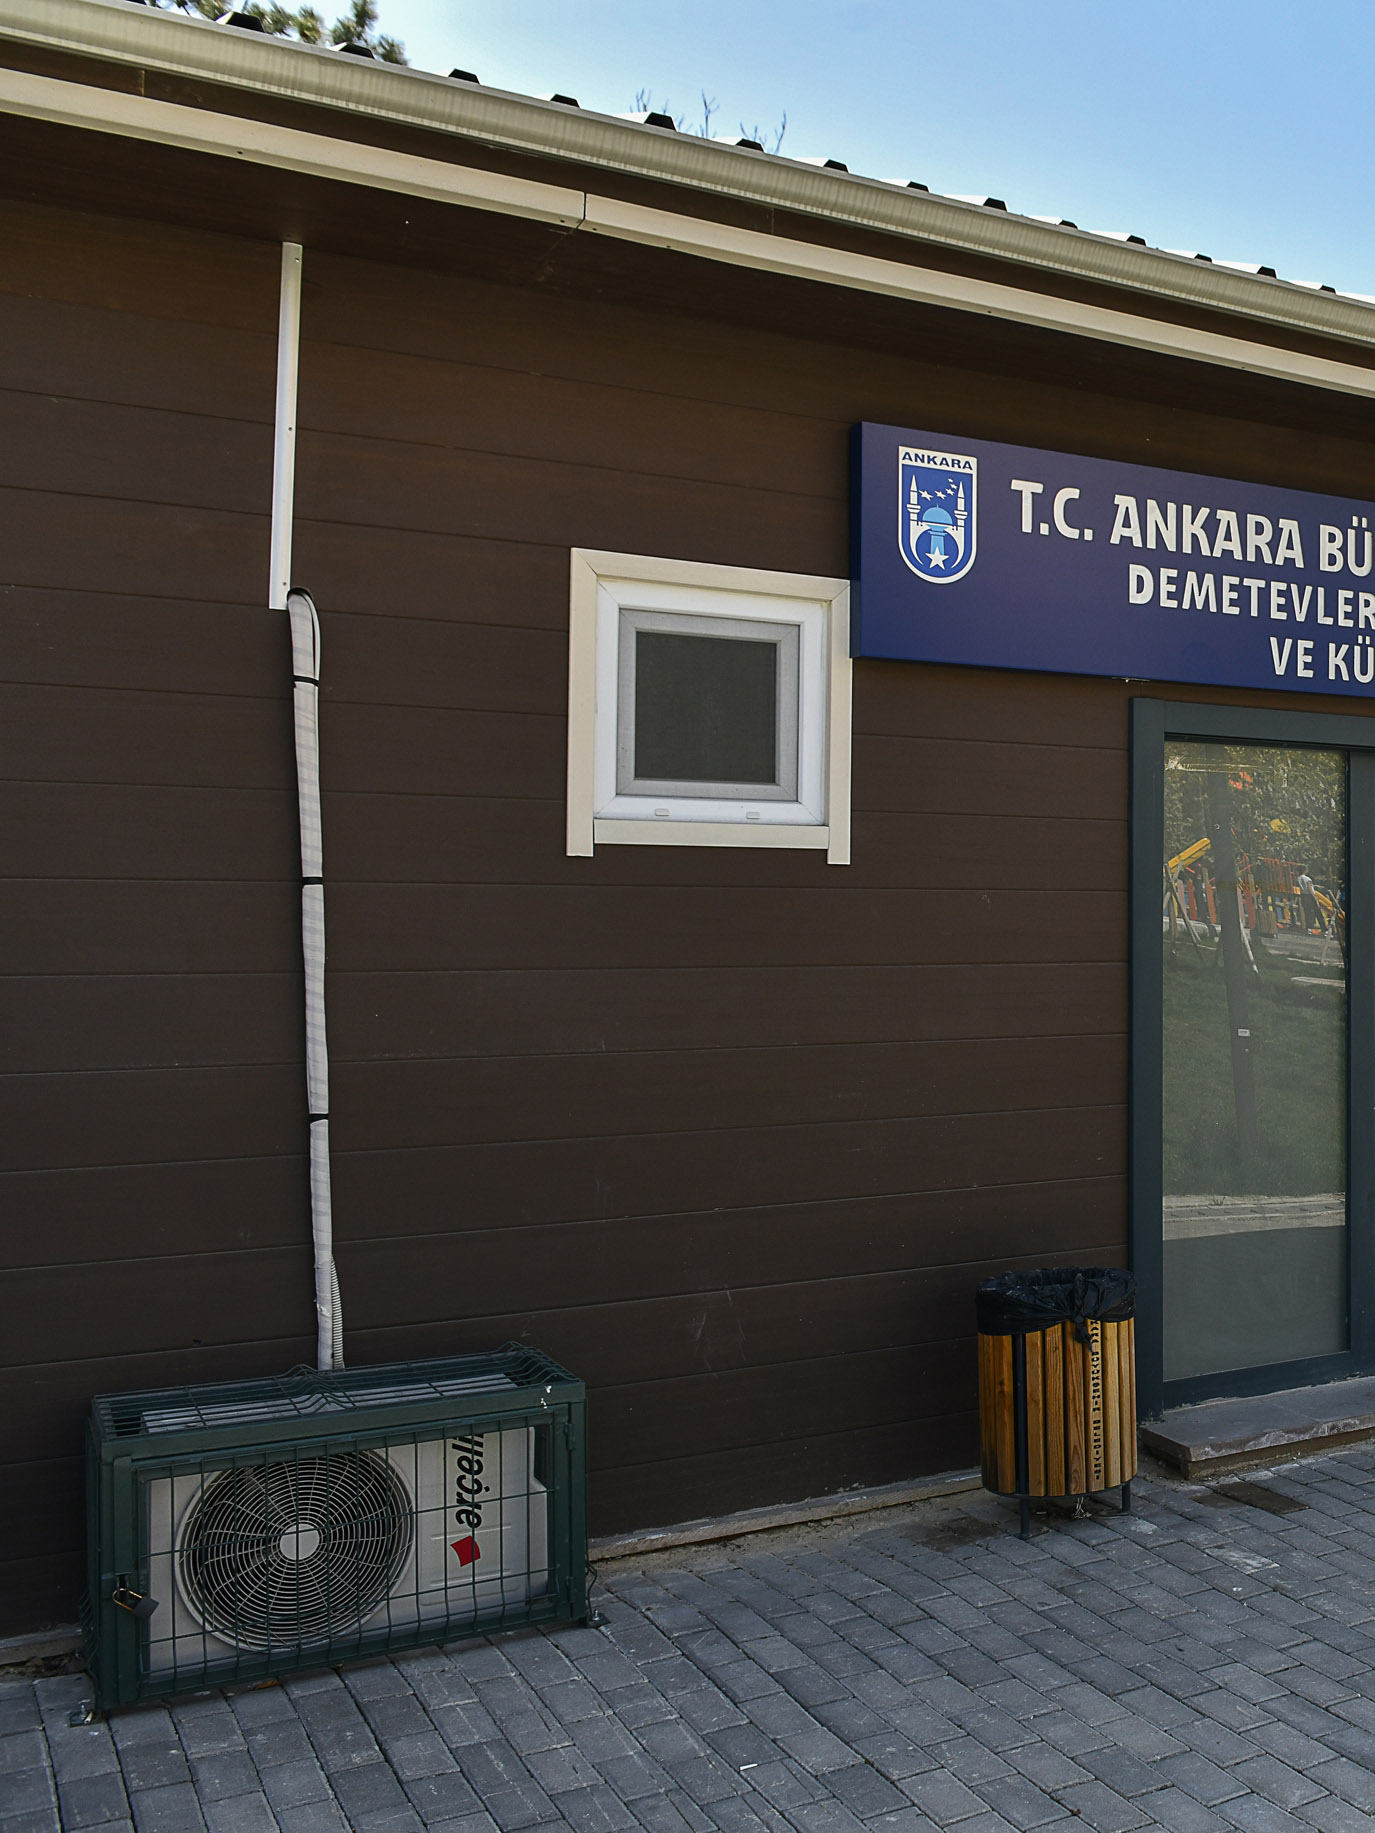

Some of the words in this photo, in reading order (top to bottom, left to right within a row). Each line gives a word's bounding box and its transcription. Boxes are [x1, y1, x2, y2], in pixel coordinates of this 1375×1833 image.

[902, 451, 973, 471] ANKARA
[1010, 478, 1094, 541] T.C.
[1110, 493, 1305, 569] ANKARA
[1269, 636, 1315, 679] VE
[451, 1433, 490, 1529] arçeli
